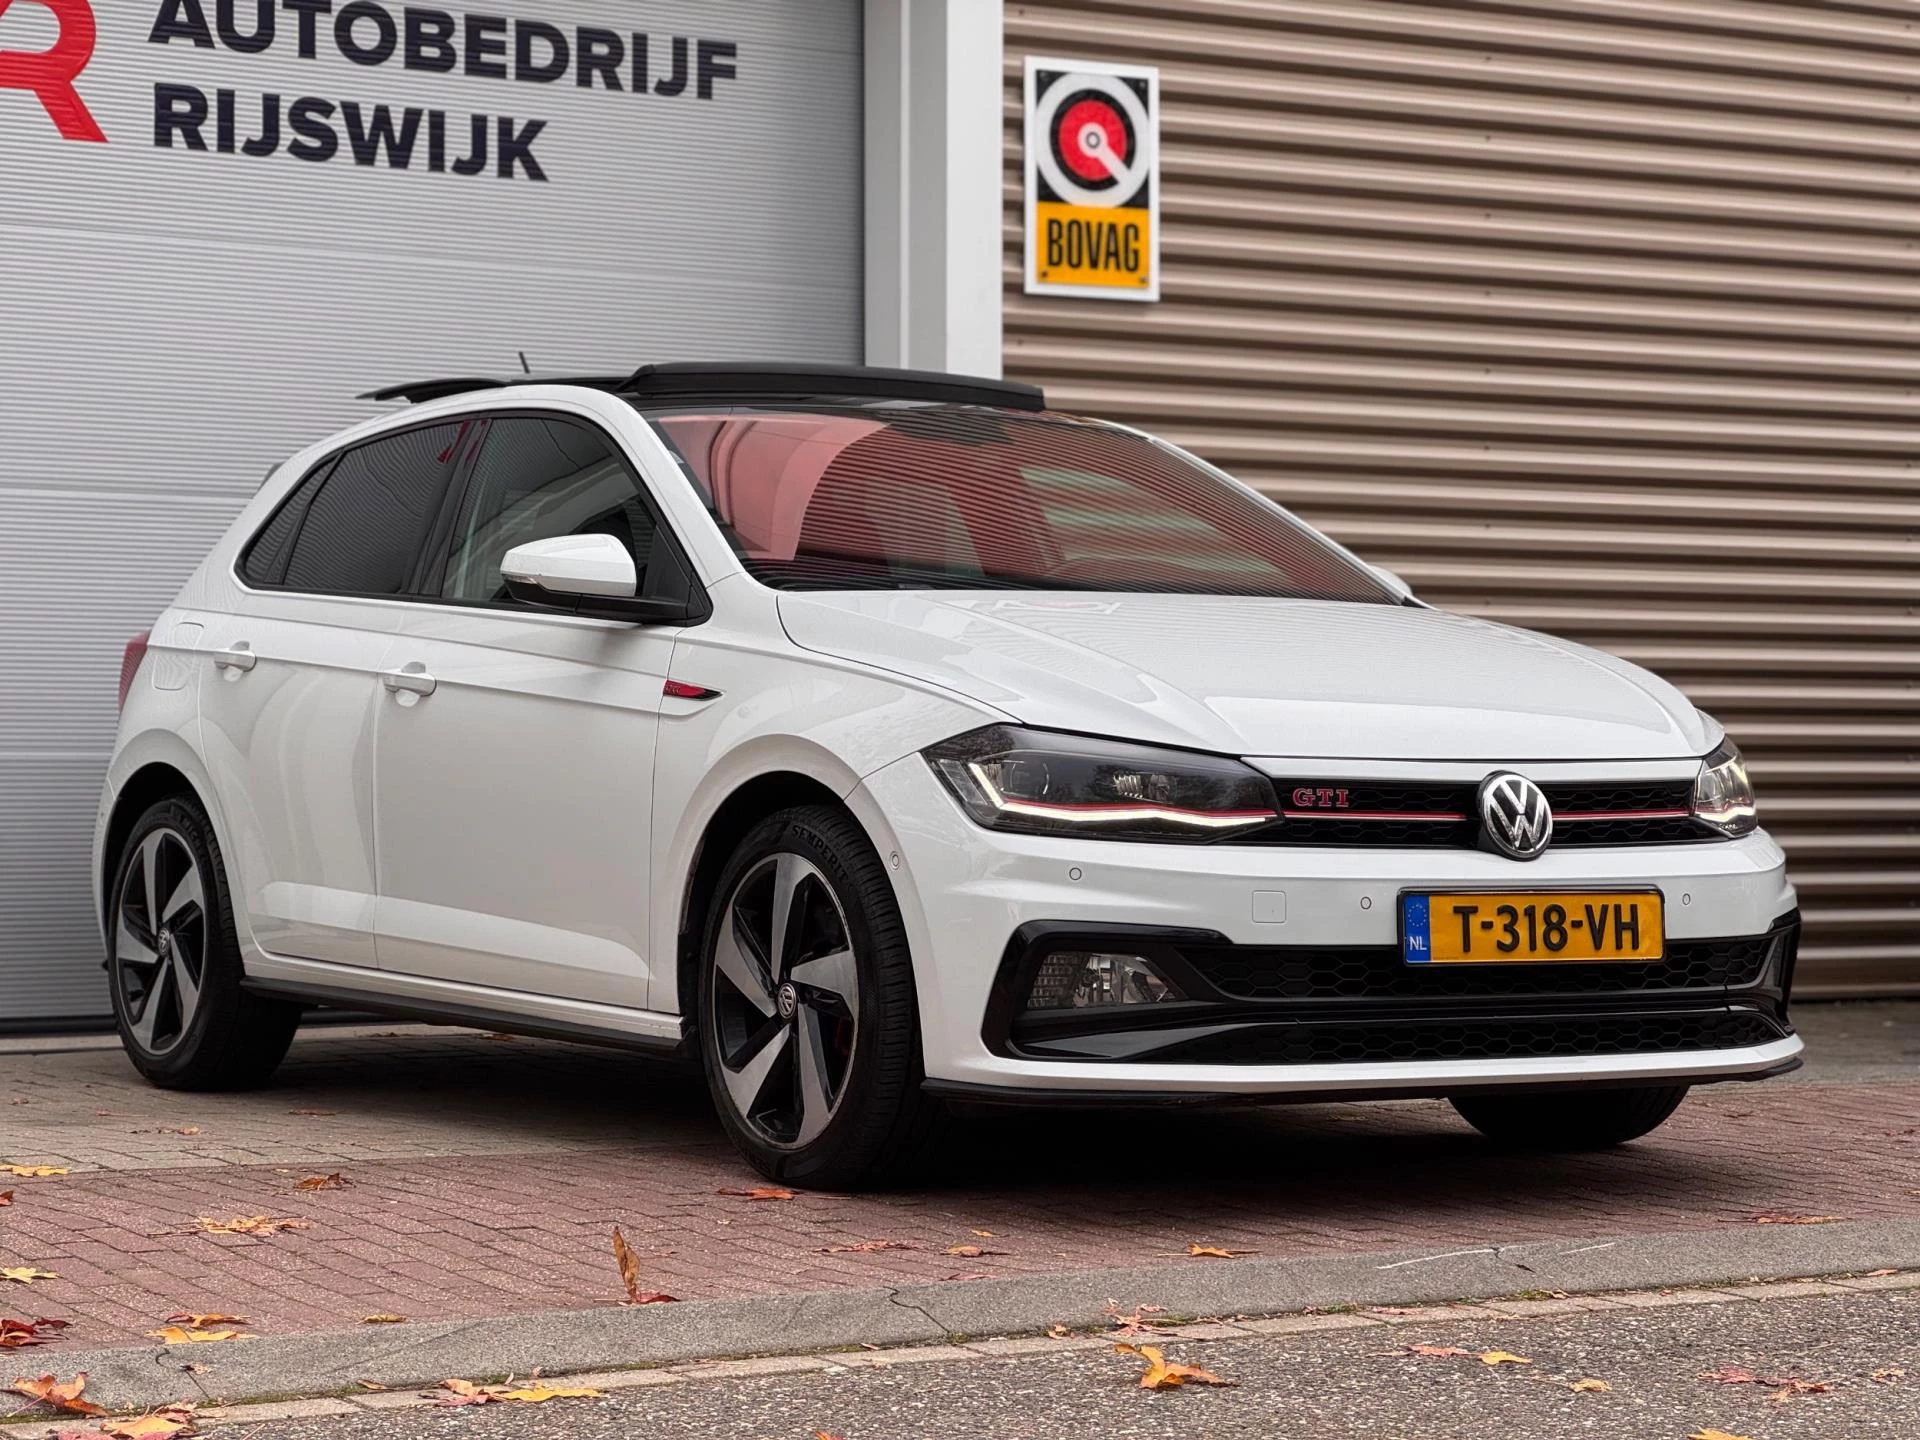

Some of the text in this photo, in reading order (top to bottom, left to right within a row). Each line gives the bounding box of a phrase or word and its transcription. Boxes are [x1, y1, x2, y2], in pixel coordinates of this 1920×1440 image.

[148, 0, 737, 100] AUTOBEDRIJF
[154, 83, 548, 182] RIJSWIJK
[1047, 218, 1139, 272] BOVAG
[1292, 788, 1349, 807] GTI
[791, 825, 849, 882] SEMPERIT
[1409, 936, 1427, 951] NL
[1453, 904, 1640, 953] T-318-VH
